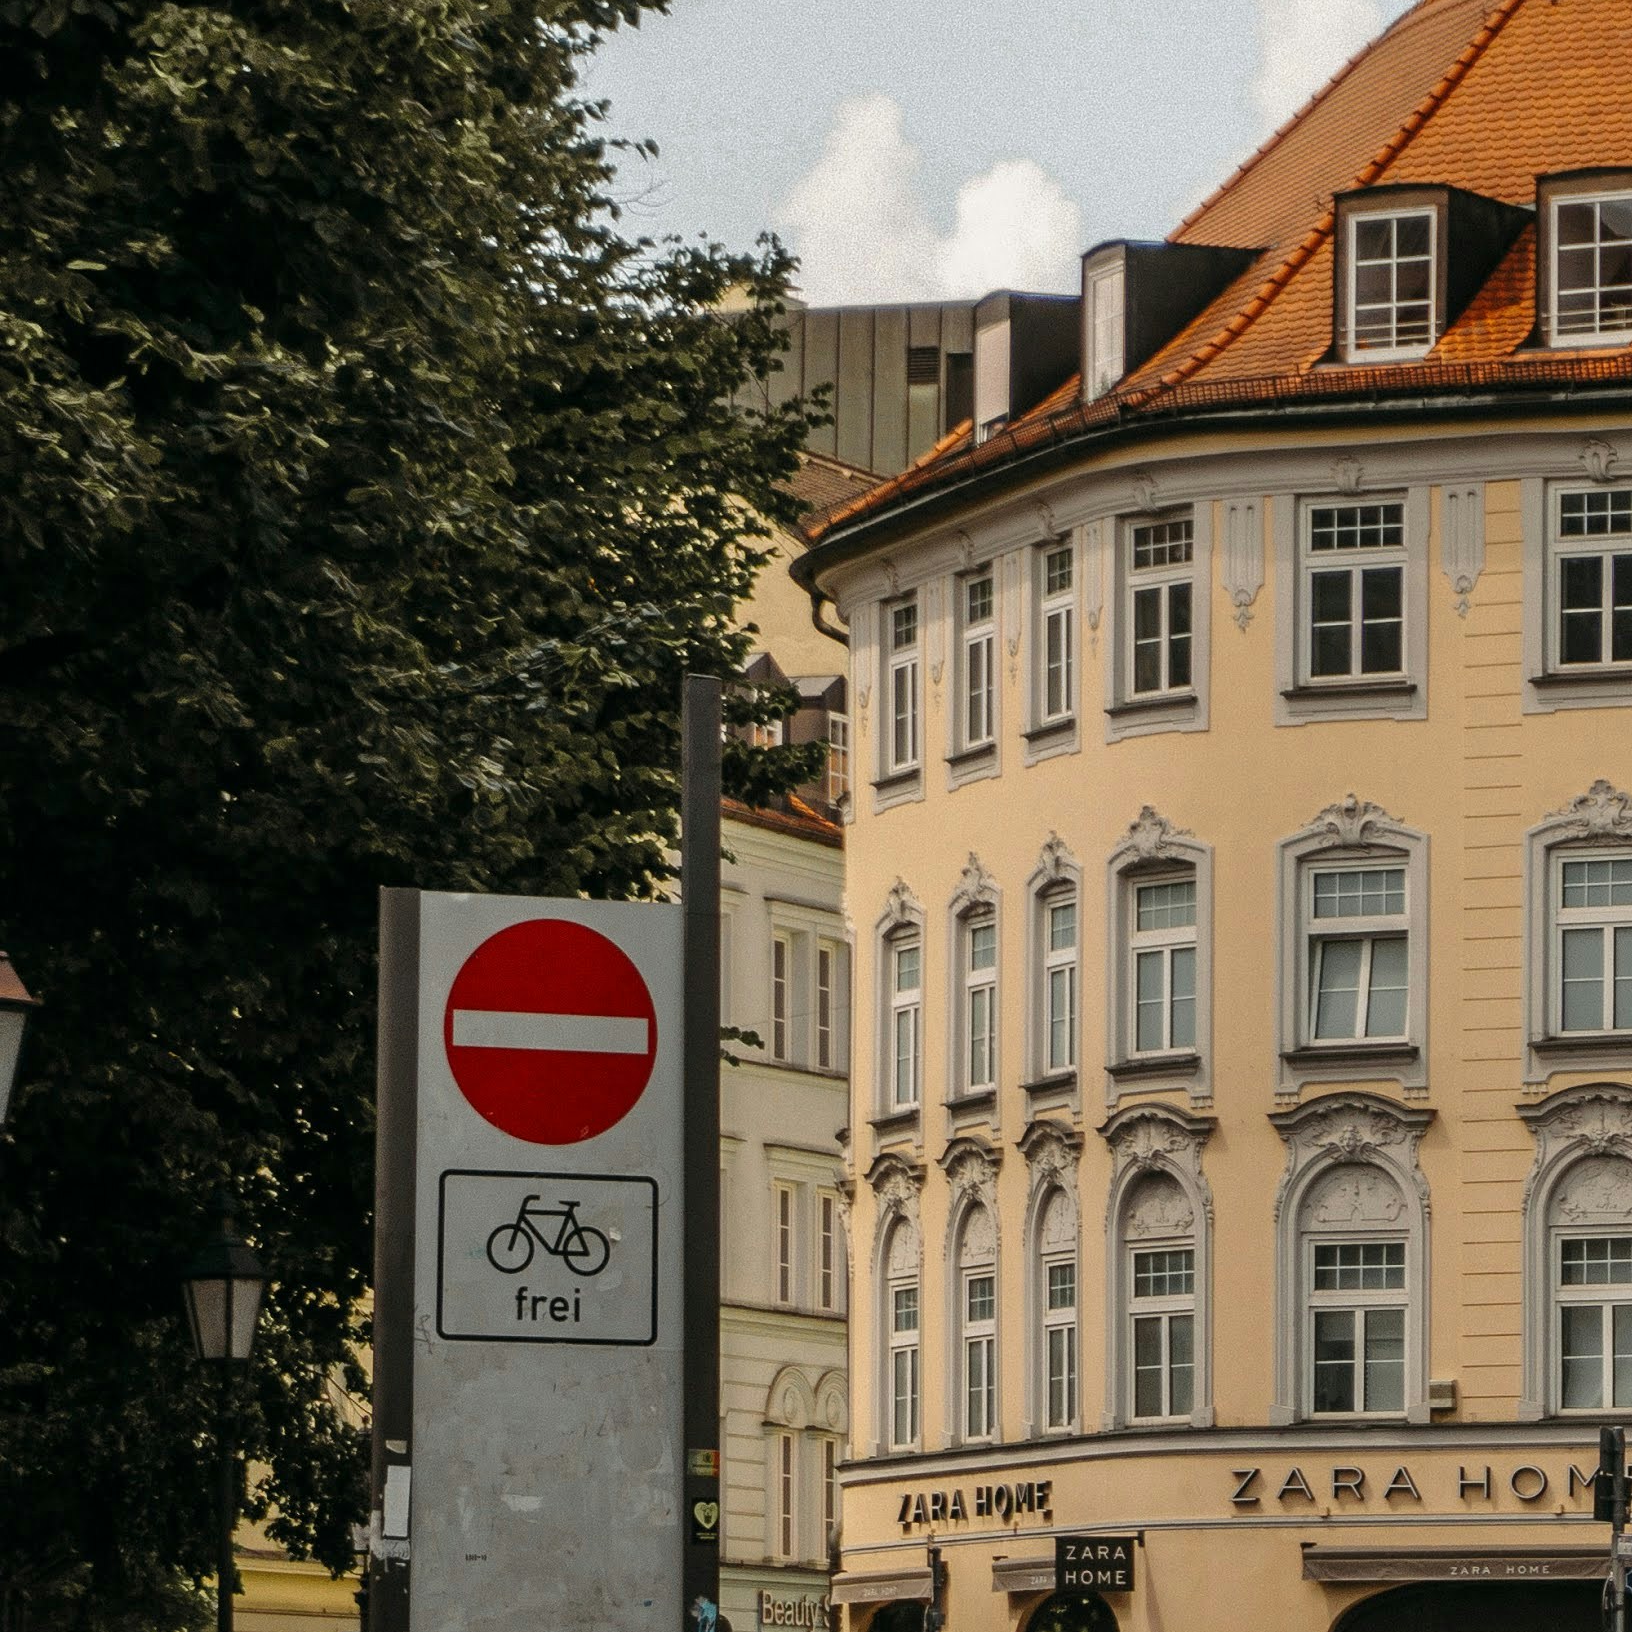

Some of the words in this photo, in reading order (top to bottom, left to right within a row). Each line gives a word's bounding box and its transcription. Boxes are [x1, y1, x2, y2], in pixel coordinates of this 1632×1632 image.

[515, 1285, 581, 1323] frei
[1232, 1466, 1421, 1503] ZARA
[897, 1488, 968, 1526] ZARA
[976, 1481, 1052, 1518] HOME
[1066, 1545, 1127, 1561] ZARA
[1065, 1570, 1127, 1585] HOME
[1450, 1566, 1492, 1576] ZARA
[1506, 1565, 1551, 1575] HOME
